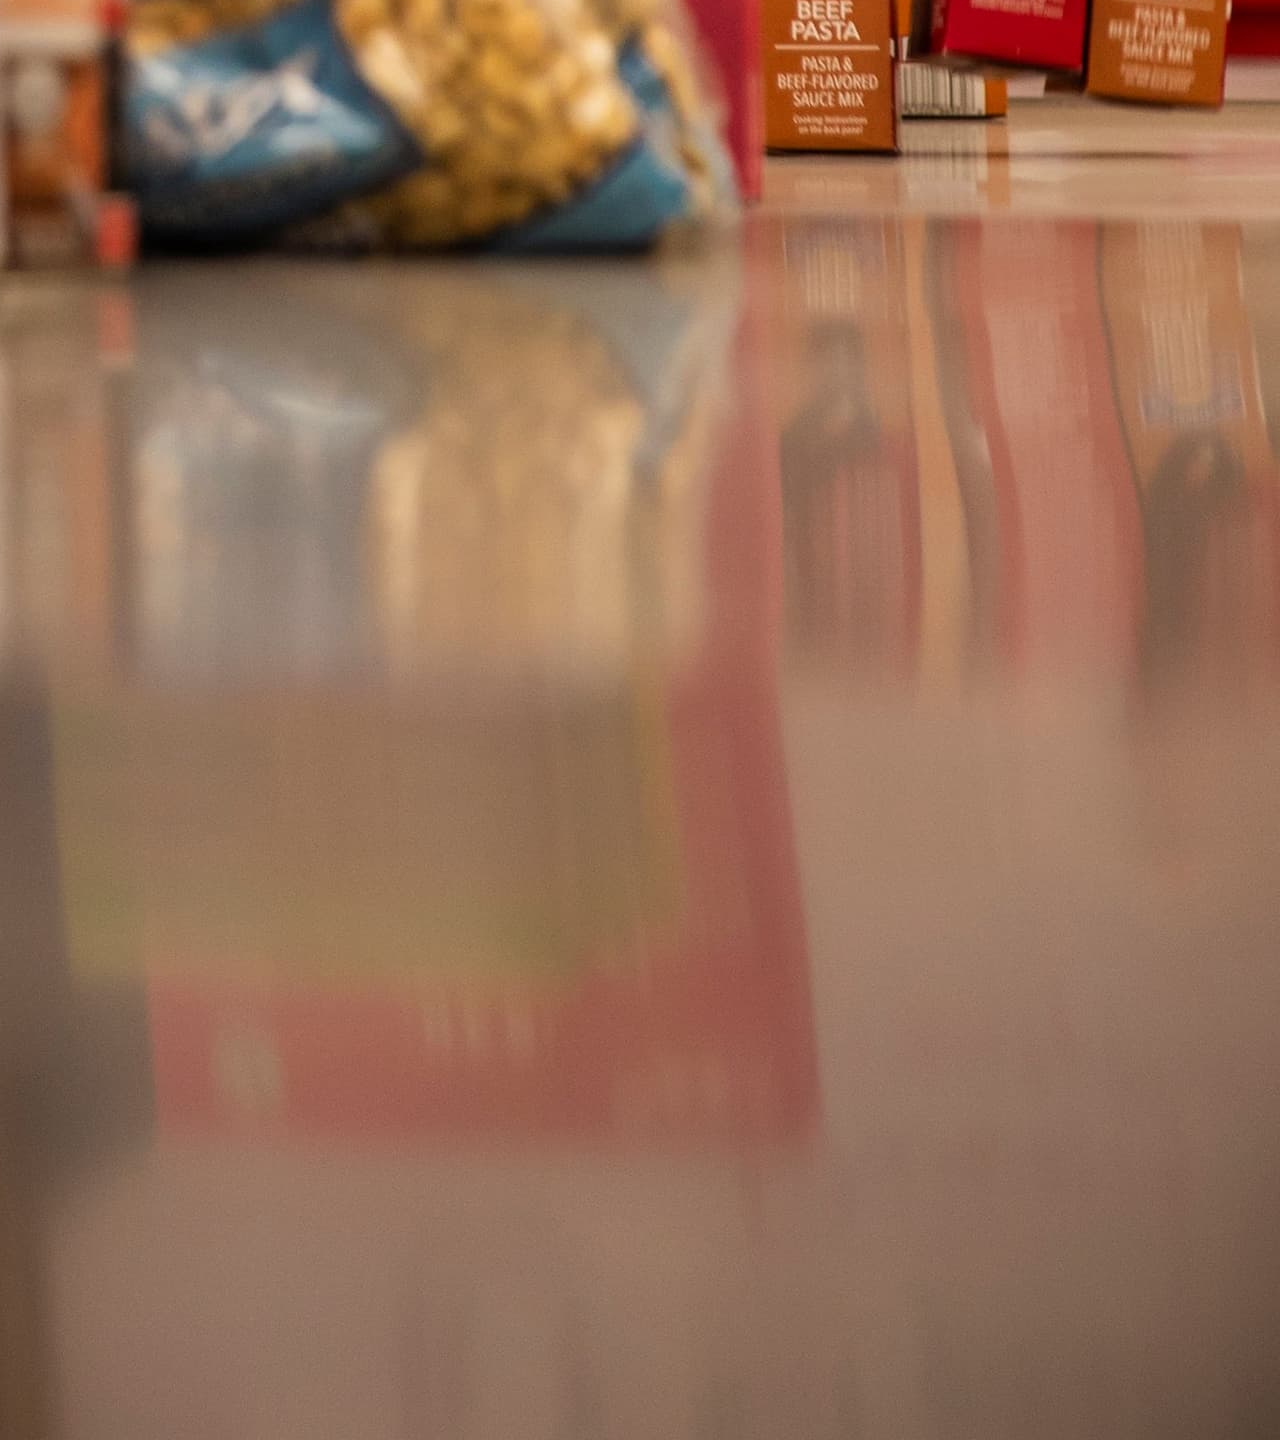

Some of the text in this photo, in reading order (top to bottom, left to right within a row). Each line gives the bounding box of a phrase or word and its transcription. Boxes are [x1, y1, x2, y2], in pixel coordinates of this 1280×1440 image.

[796, 0, 854, 21] BEEF
[792, 20, 861, 41] PASTA
[801, 55, 854, 73] PASTA &
[777, 73, 879, 91] BEEF-FLAVORED
[792, 91, 865, 108] SAUCE MIX
